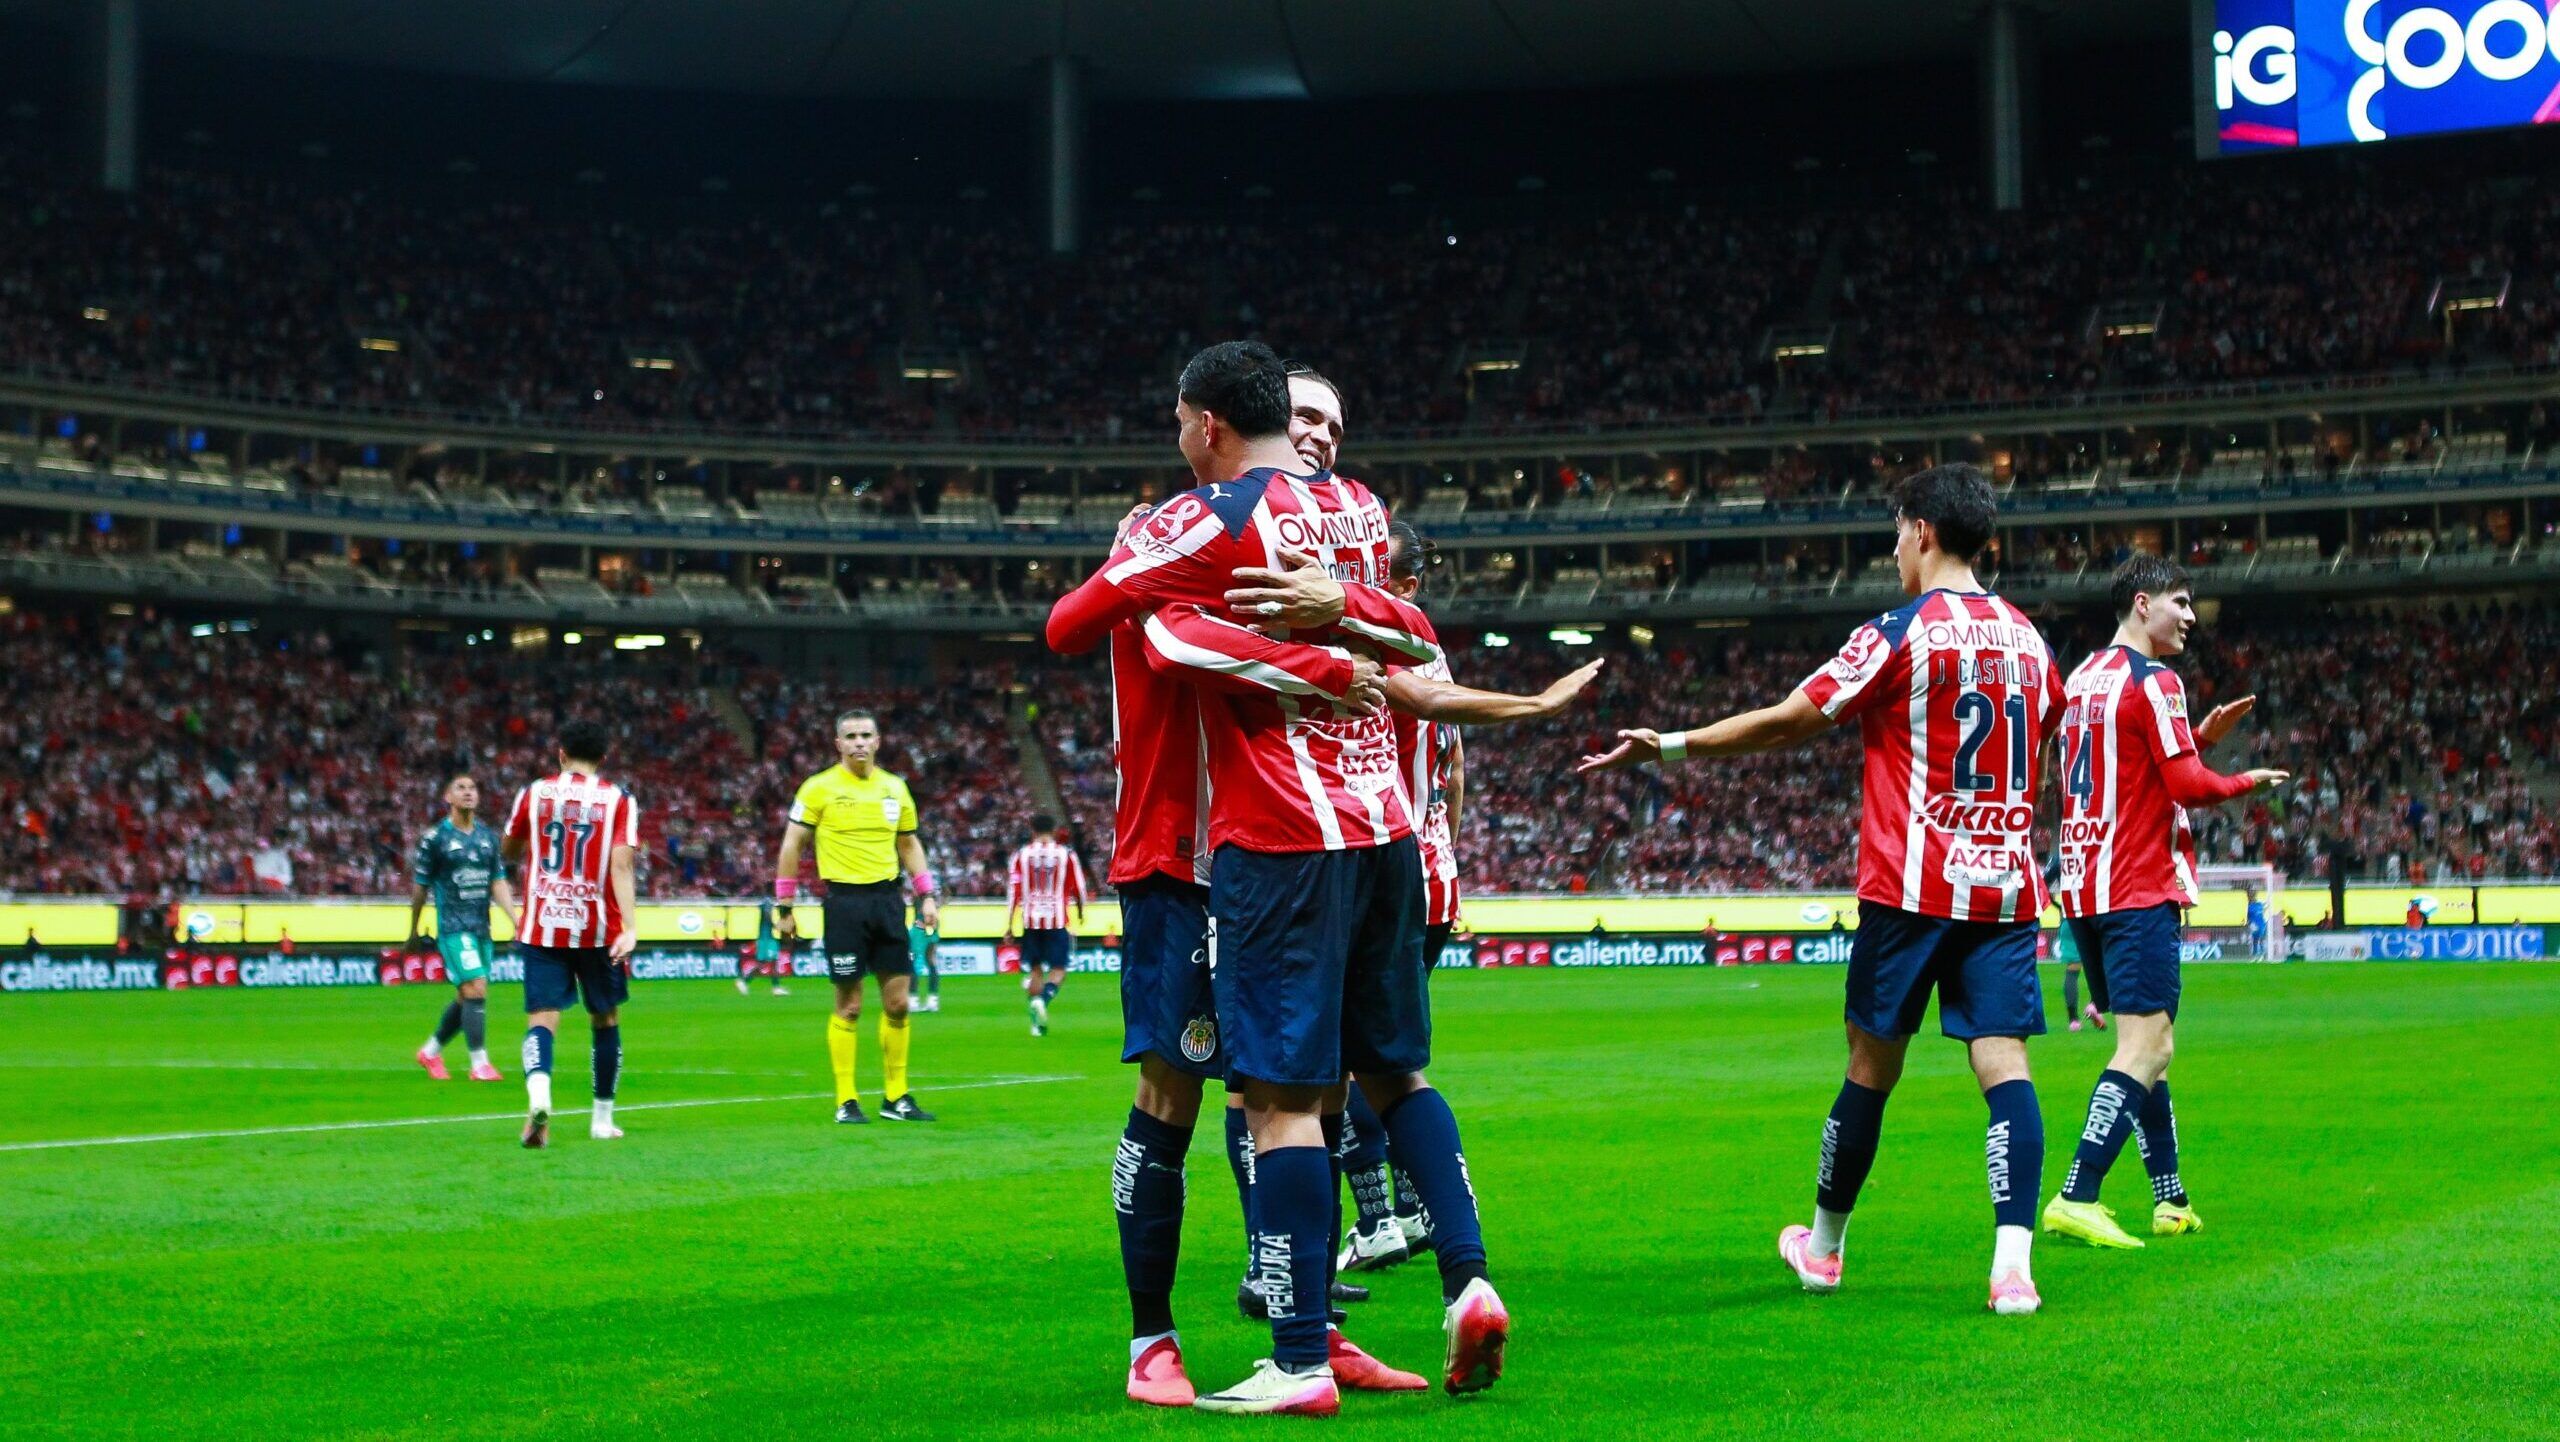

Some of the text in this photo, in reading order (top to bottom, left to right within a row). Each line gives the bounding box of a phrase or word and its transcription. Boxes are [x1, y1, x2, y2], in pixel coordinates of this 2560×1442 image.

[1279, 507, 1385, 546] OMNILIFE
[1928, 624, 2036, 653] OMNILIFE
[1953, 692, 2028, 791] 21
[541, 821, 594, 876] 37
[1949, 847, 2026, 871] AXEN
[631, 951, 738, 979] caliente.mx
[1554, 938, 1706, 965] caliente.mx
[0, 953, 157, 991] caliente.mx
[239, 953, 377, 986] caliente.mx
